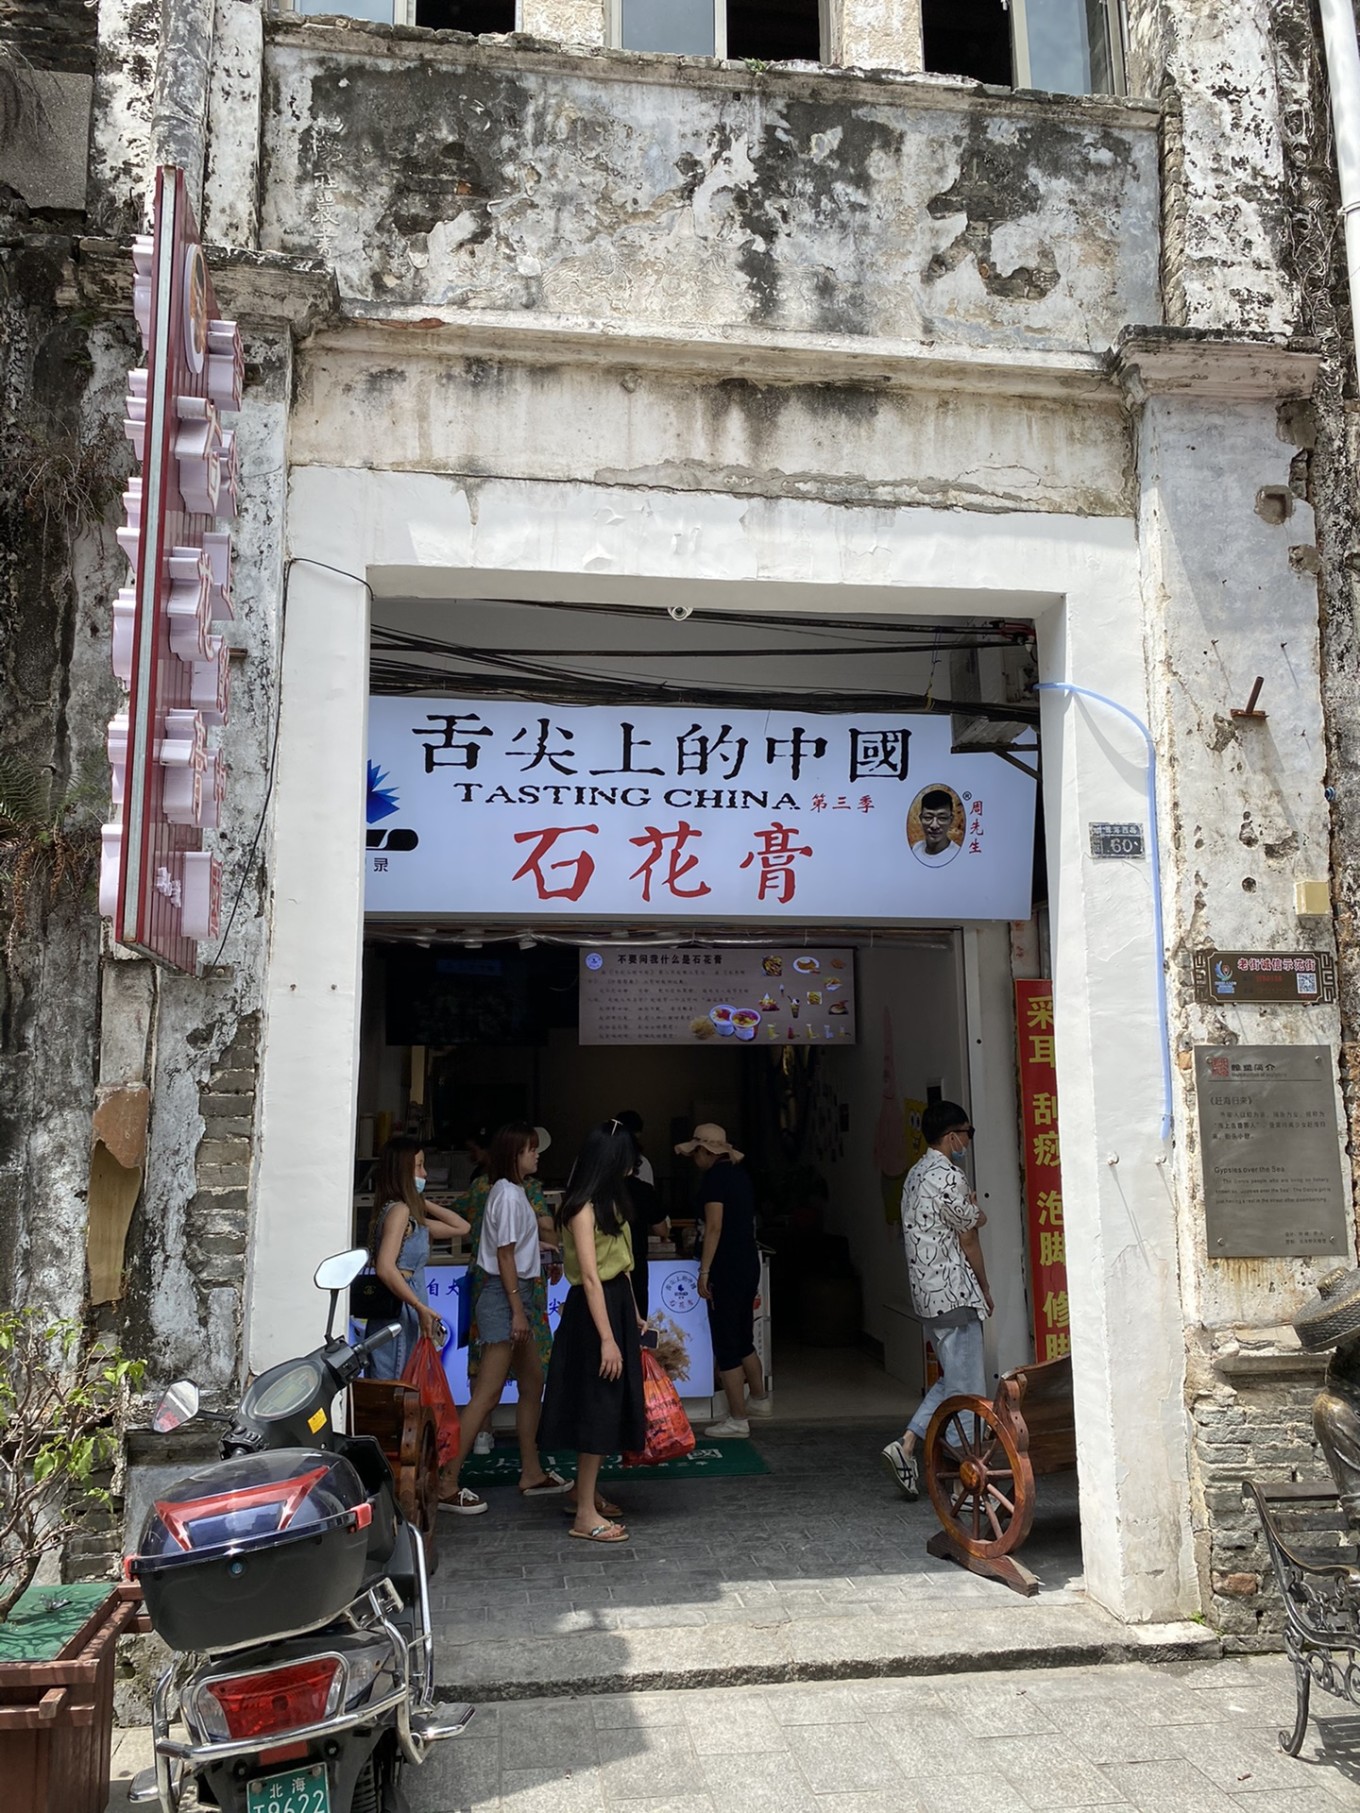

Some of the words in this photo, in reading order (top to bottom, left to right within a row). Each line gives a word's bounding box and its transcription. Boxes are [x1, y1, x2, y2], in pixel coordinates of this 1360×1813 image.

[411, 713, 912, 783] 舌尖上的中國
[453, 783, 651, 807] TASTING
[663, 789, 800, 810] CHINA
[810, 793, 876, 813] 第三季
[969, 800, 984, 855] 周先生
[1110, 838, 1133, 853] 60
[512, 820, 813, 904] 石花膏
[1237, 957, 1317, 972] 老街诚信示范街
[269, 1777, 306, 1799] 北海
